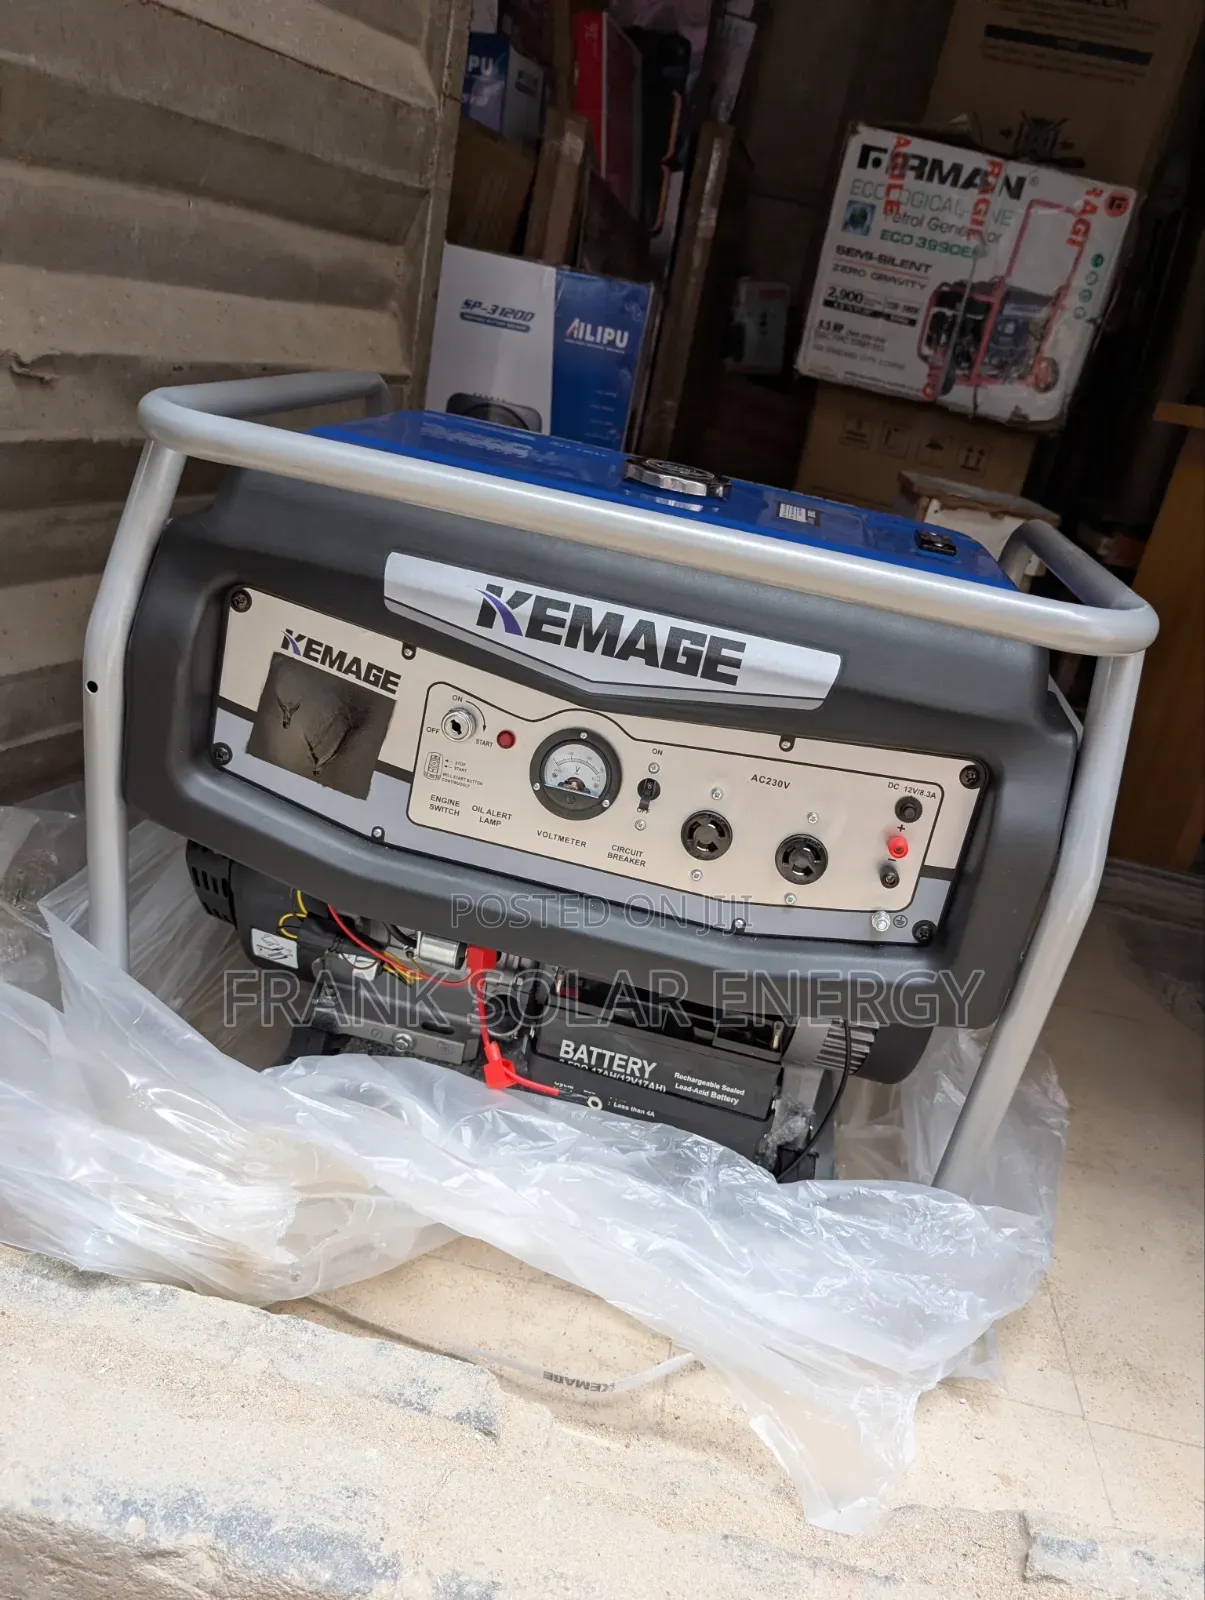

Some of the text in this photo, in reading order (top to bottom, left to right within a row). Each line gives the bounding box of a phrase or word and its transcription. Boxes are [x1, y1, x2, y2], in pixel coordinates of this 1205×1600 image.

[850, 179, 965, 216] ECOOGICAL
[880, 229, 913, 246] ECO
[835, 244, 932, 273] SEMI-SILENT
[832, 263, 927, 291] ZERO GRAVITY
[565, 317, 630, 349] AILIPU
[475, 583, 747, 686] KEMAGE
[281, 628, 402, 695] KEMAGE
[452, 694, 463, 703] ON
[426, 726, 440, 734] OFF
[475, 738, 494, 748] START
[652, 748, 663, 756] ON
[750, 773, 791, 791] AC230V
[887, 782, 937, 800] DC 12V/8.3A
[430, 794, 461, 808] ENGINE
[428, 804, 461, 818] SWITCH
[471, 804, 513, 821] OIL ALERT
[479, 816, 502, 828] LAMP
[536, 829, 587, 849] VOLTMETER
[607, 852, 646, 868] BREAKER
[611, 844, 644, 859] CIRCUIT
[559, 1039, 657, 1080] BATTERY
[674, 1071, 745, 1096] Rechargeable Sealed
[675, 1082, 740, 1106] Lead-Acid Battery
